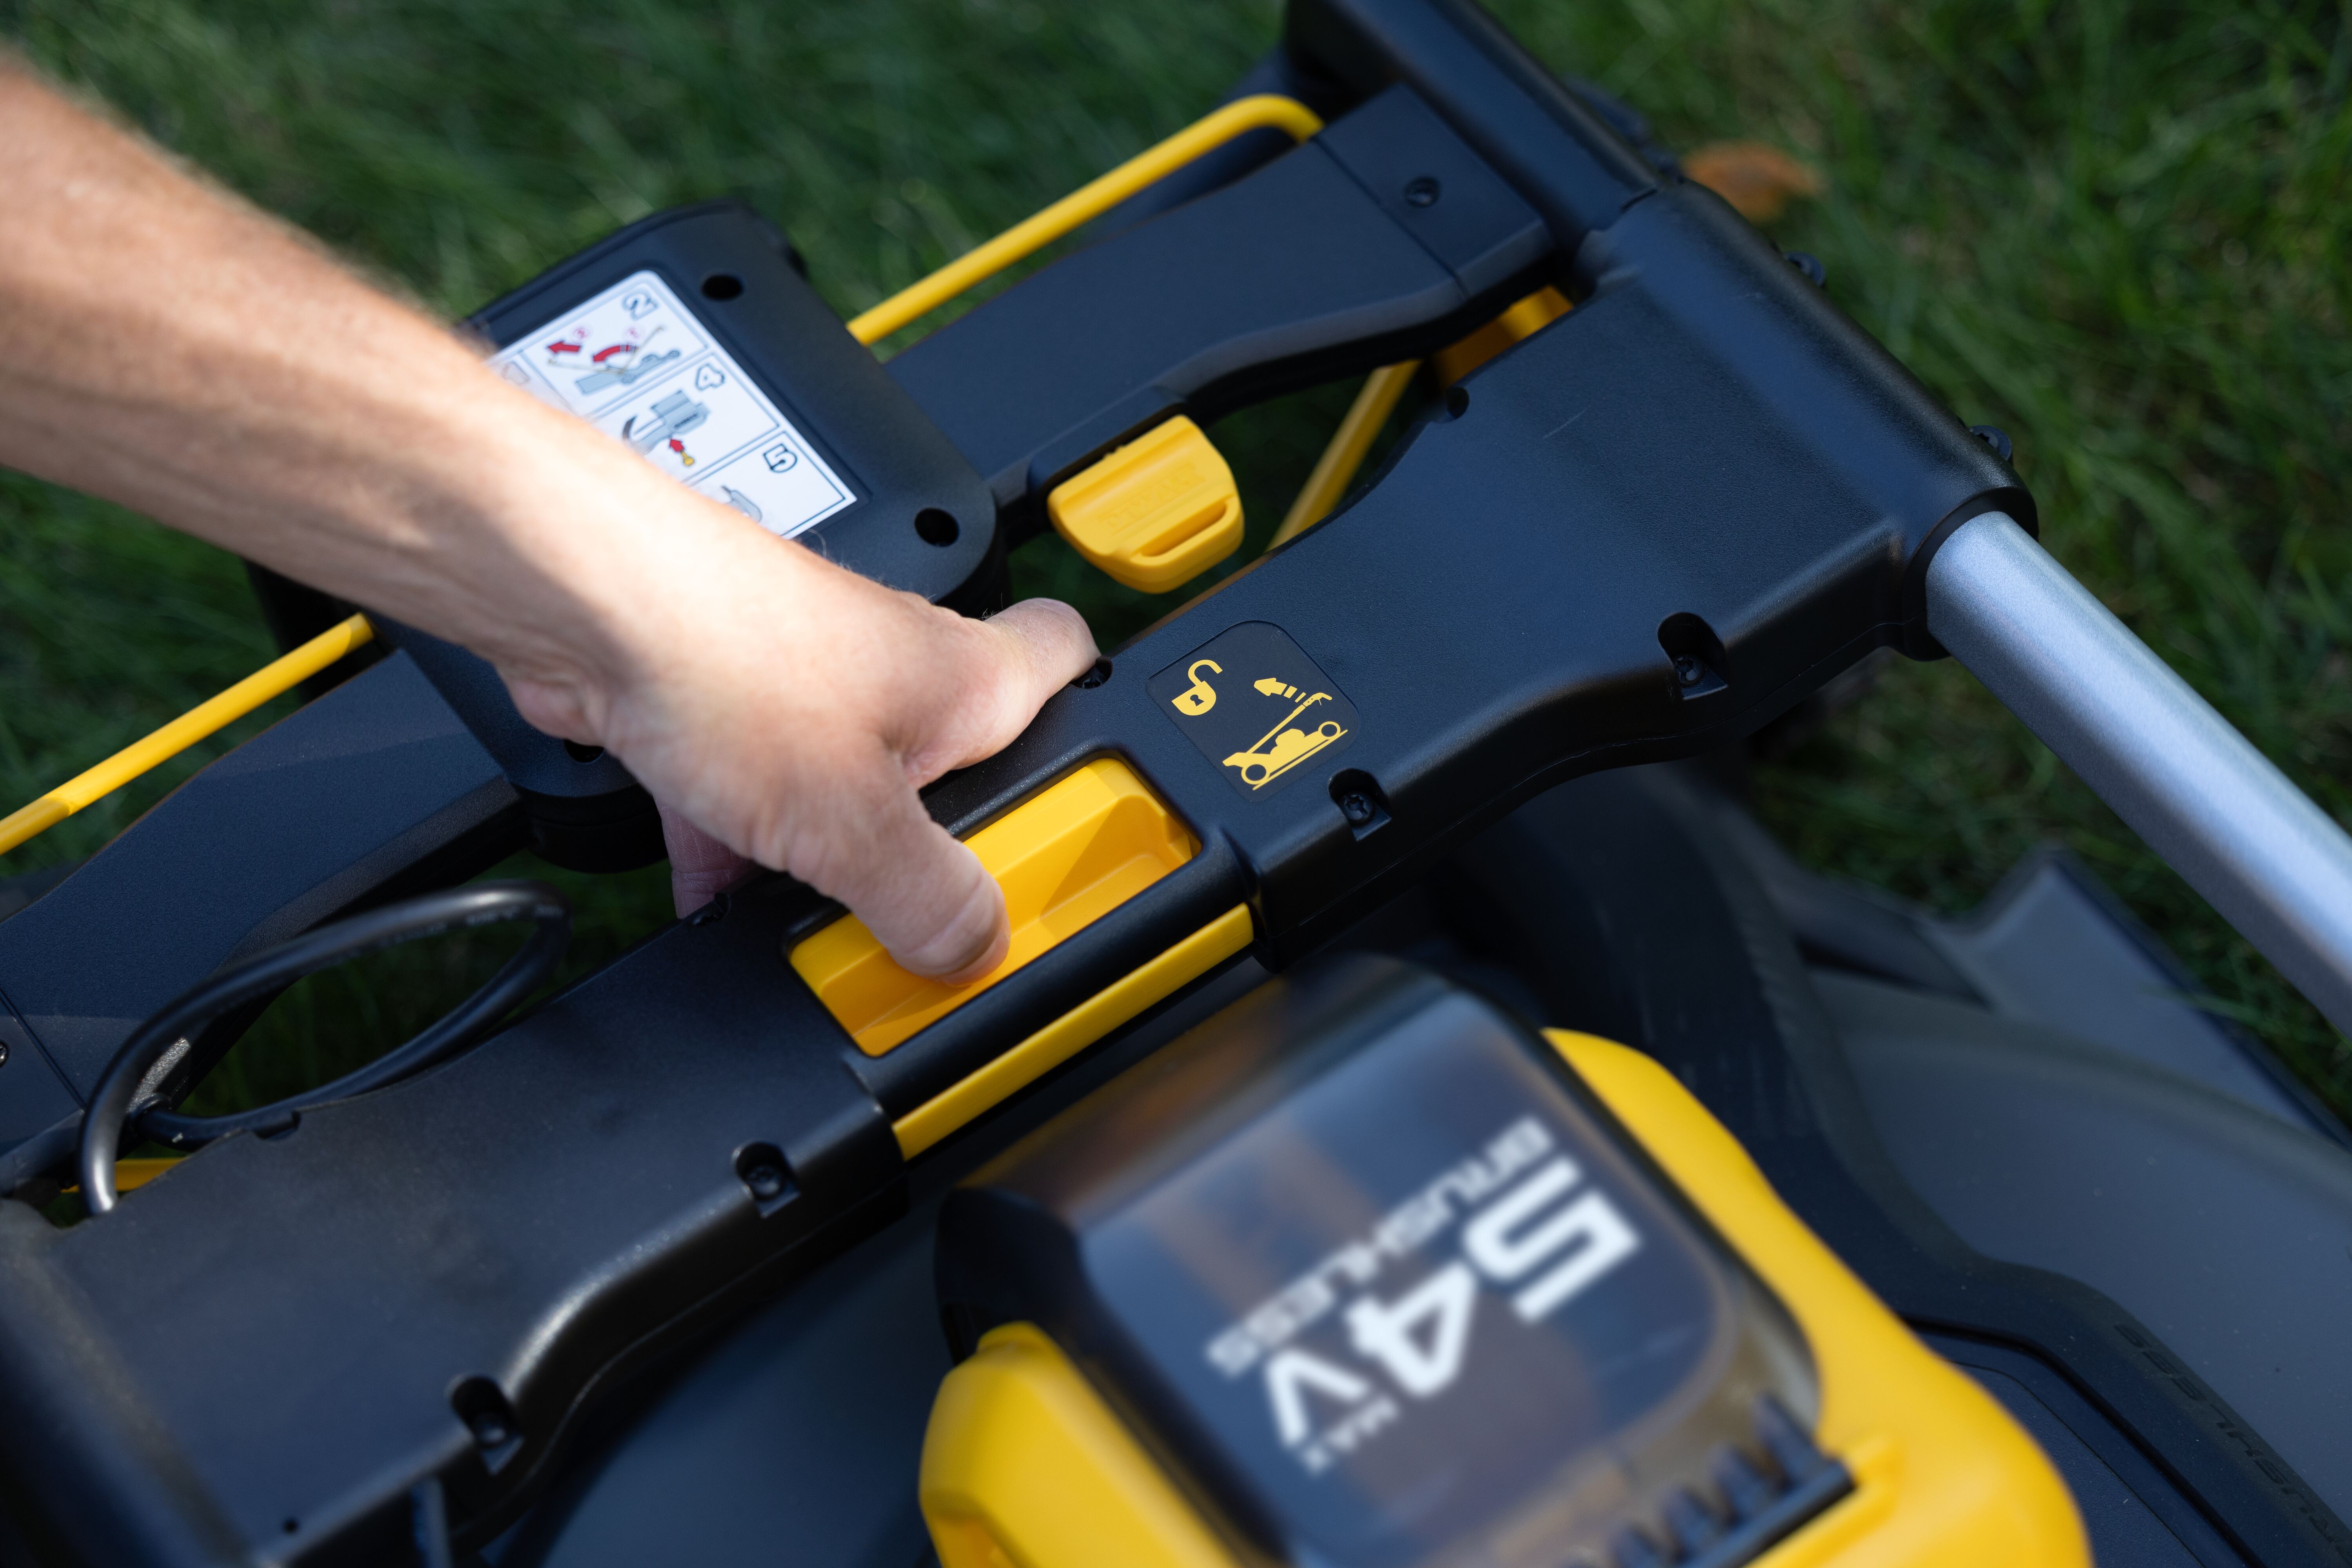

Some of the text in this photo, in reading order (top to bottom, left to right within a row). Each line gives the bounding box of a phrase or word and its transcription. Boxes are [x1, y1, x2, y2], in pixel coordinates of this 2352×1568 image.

[622, 293, 659, 321] 2
[695, 364, 725, 391] 4
[763, 443, 798, 473] 5
[1205, 1114, 1554, 1381] BRUSHLESS
[1265, 1152, 1640, 1447] 54V
